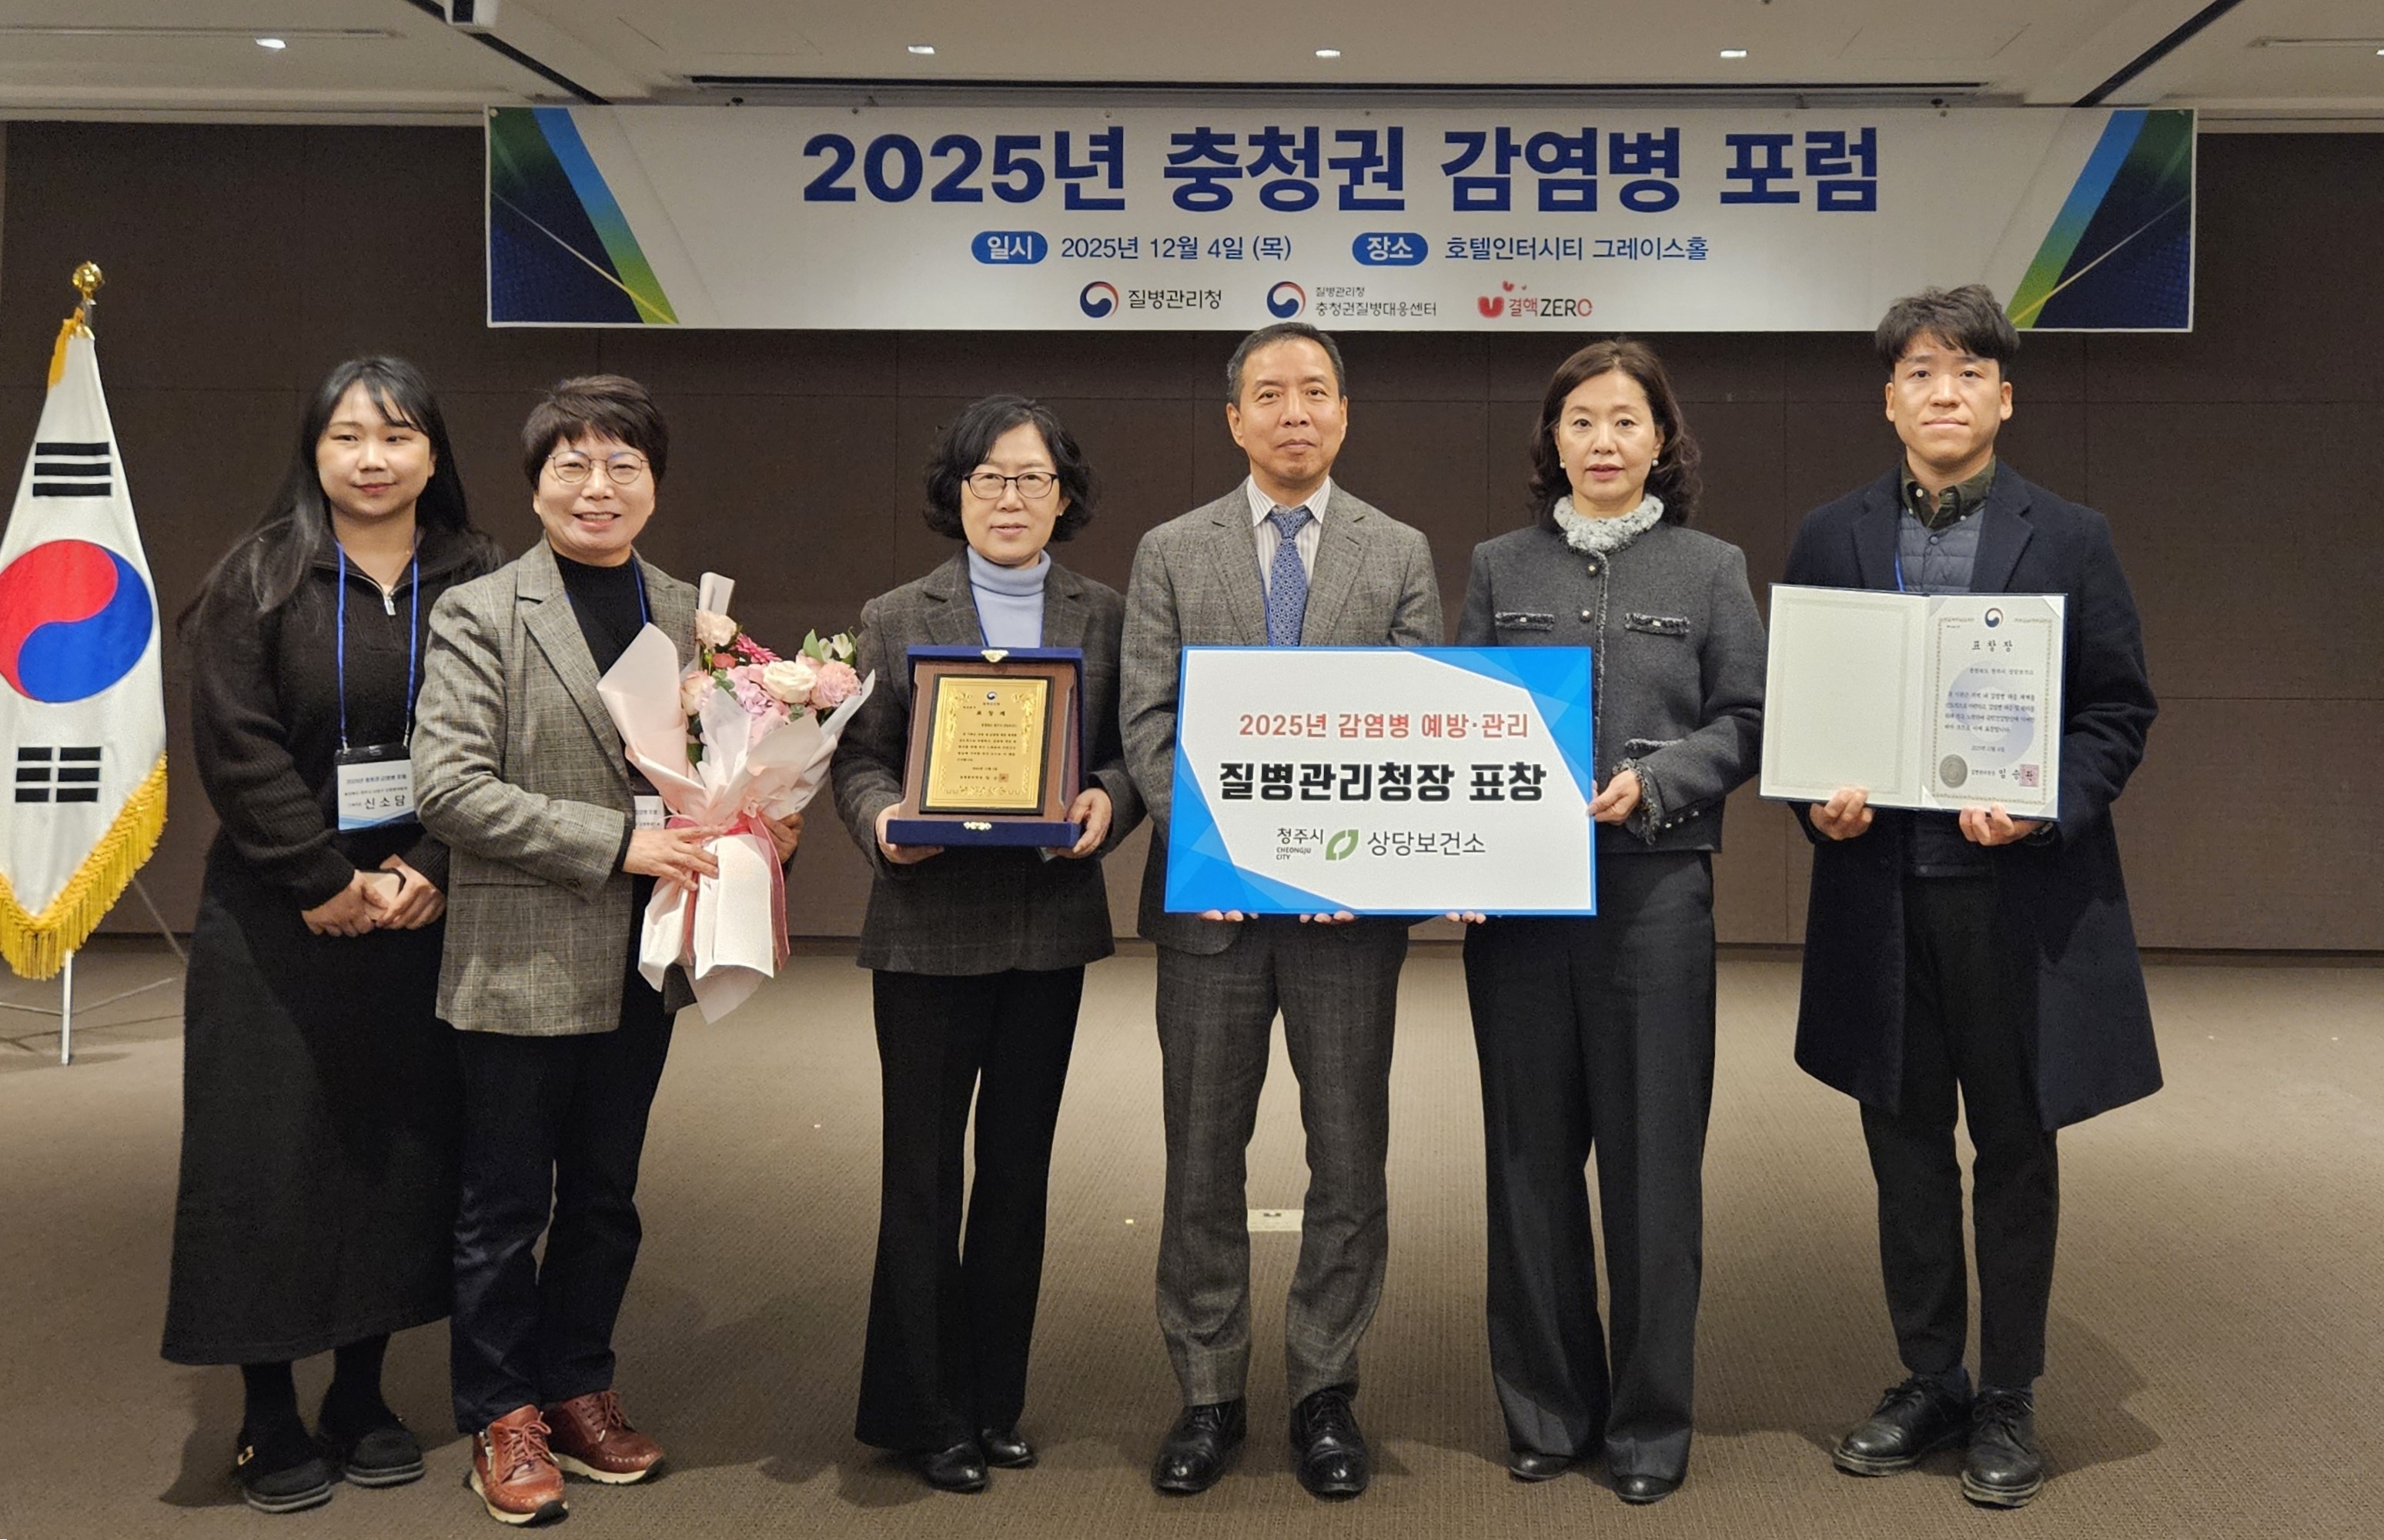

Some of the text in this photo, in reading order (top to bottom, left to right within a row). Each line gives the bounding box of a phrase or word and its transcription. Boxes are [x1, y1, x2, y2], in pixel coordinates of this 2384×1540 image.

[803, 125, 1877, 215] 2025년 충청권 감염병 포럼
[987, 236, 1032, 260] 일시
[1062, 236, 1292, 261] 2025년 12월 4일 (목)
[1366, 236, 1413, 261] 장소
[1445, 236, 1709, 261] 호텔인터시티 그레이스홀
[1128, 289, 1222, 310] 질병관리청
[1316, 286, 1365, 298] 질병관리청
[1316, 301, 1436, 317] 충청권질병대응센터
[1239, 713, 1327, 738] 2025년
[1338, 713, 1409, 739] 감염병
[1219, 761, 1547, 802] 질병관리청장 표창
[1277, 827, 1324, 845] 청주시
[1367, 830, 1486, 857] 상당보건소
[1276, 847, 1312, 855] CHEONGJU
